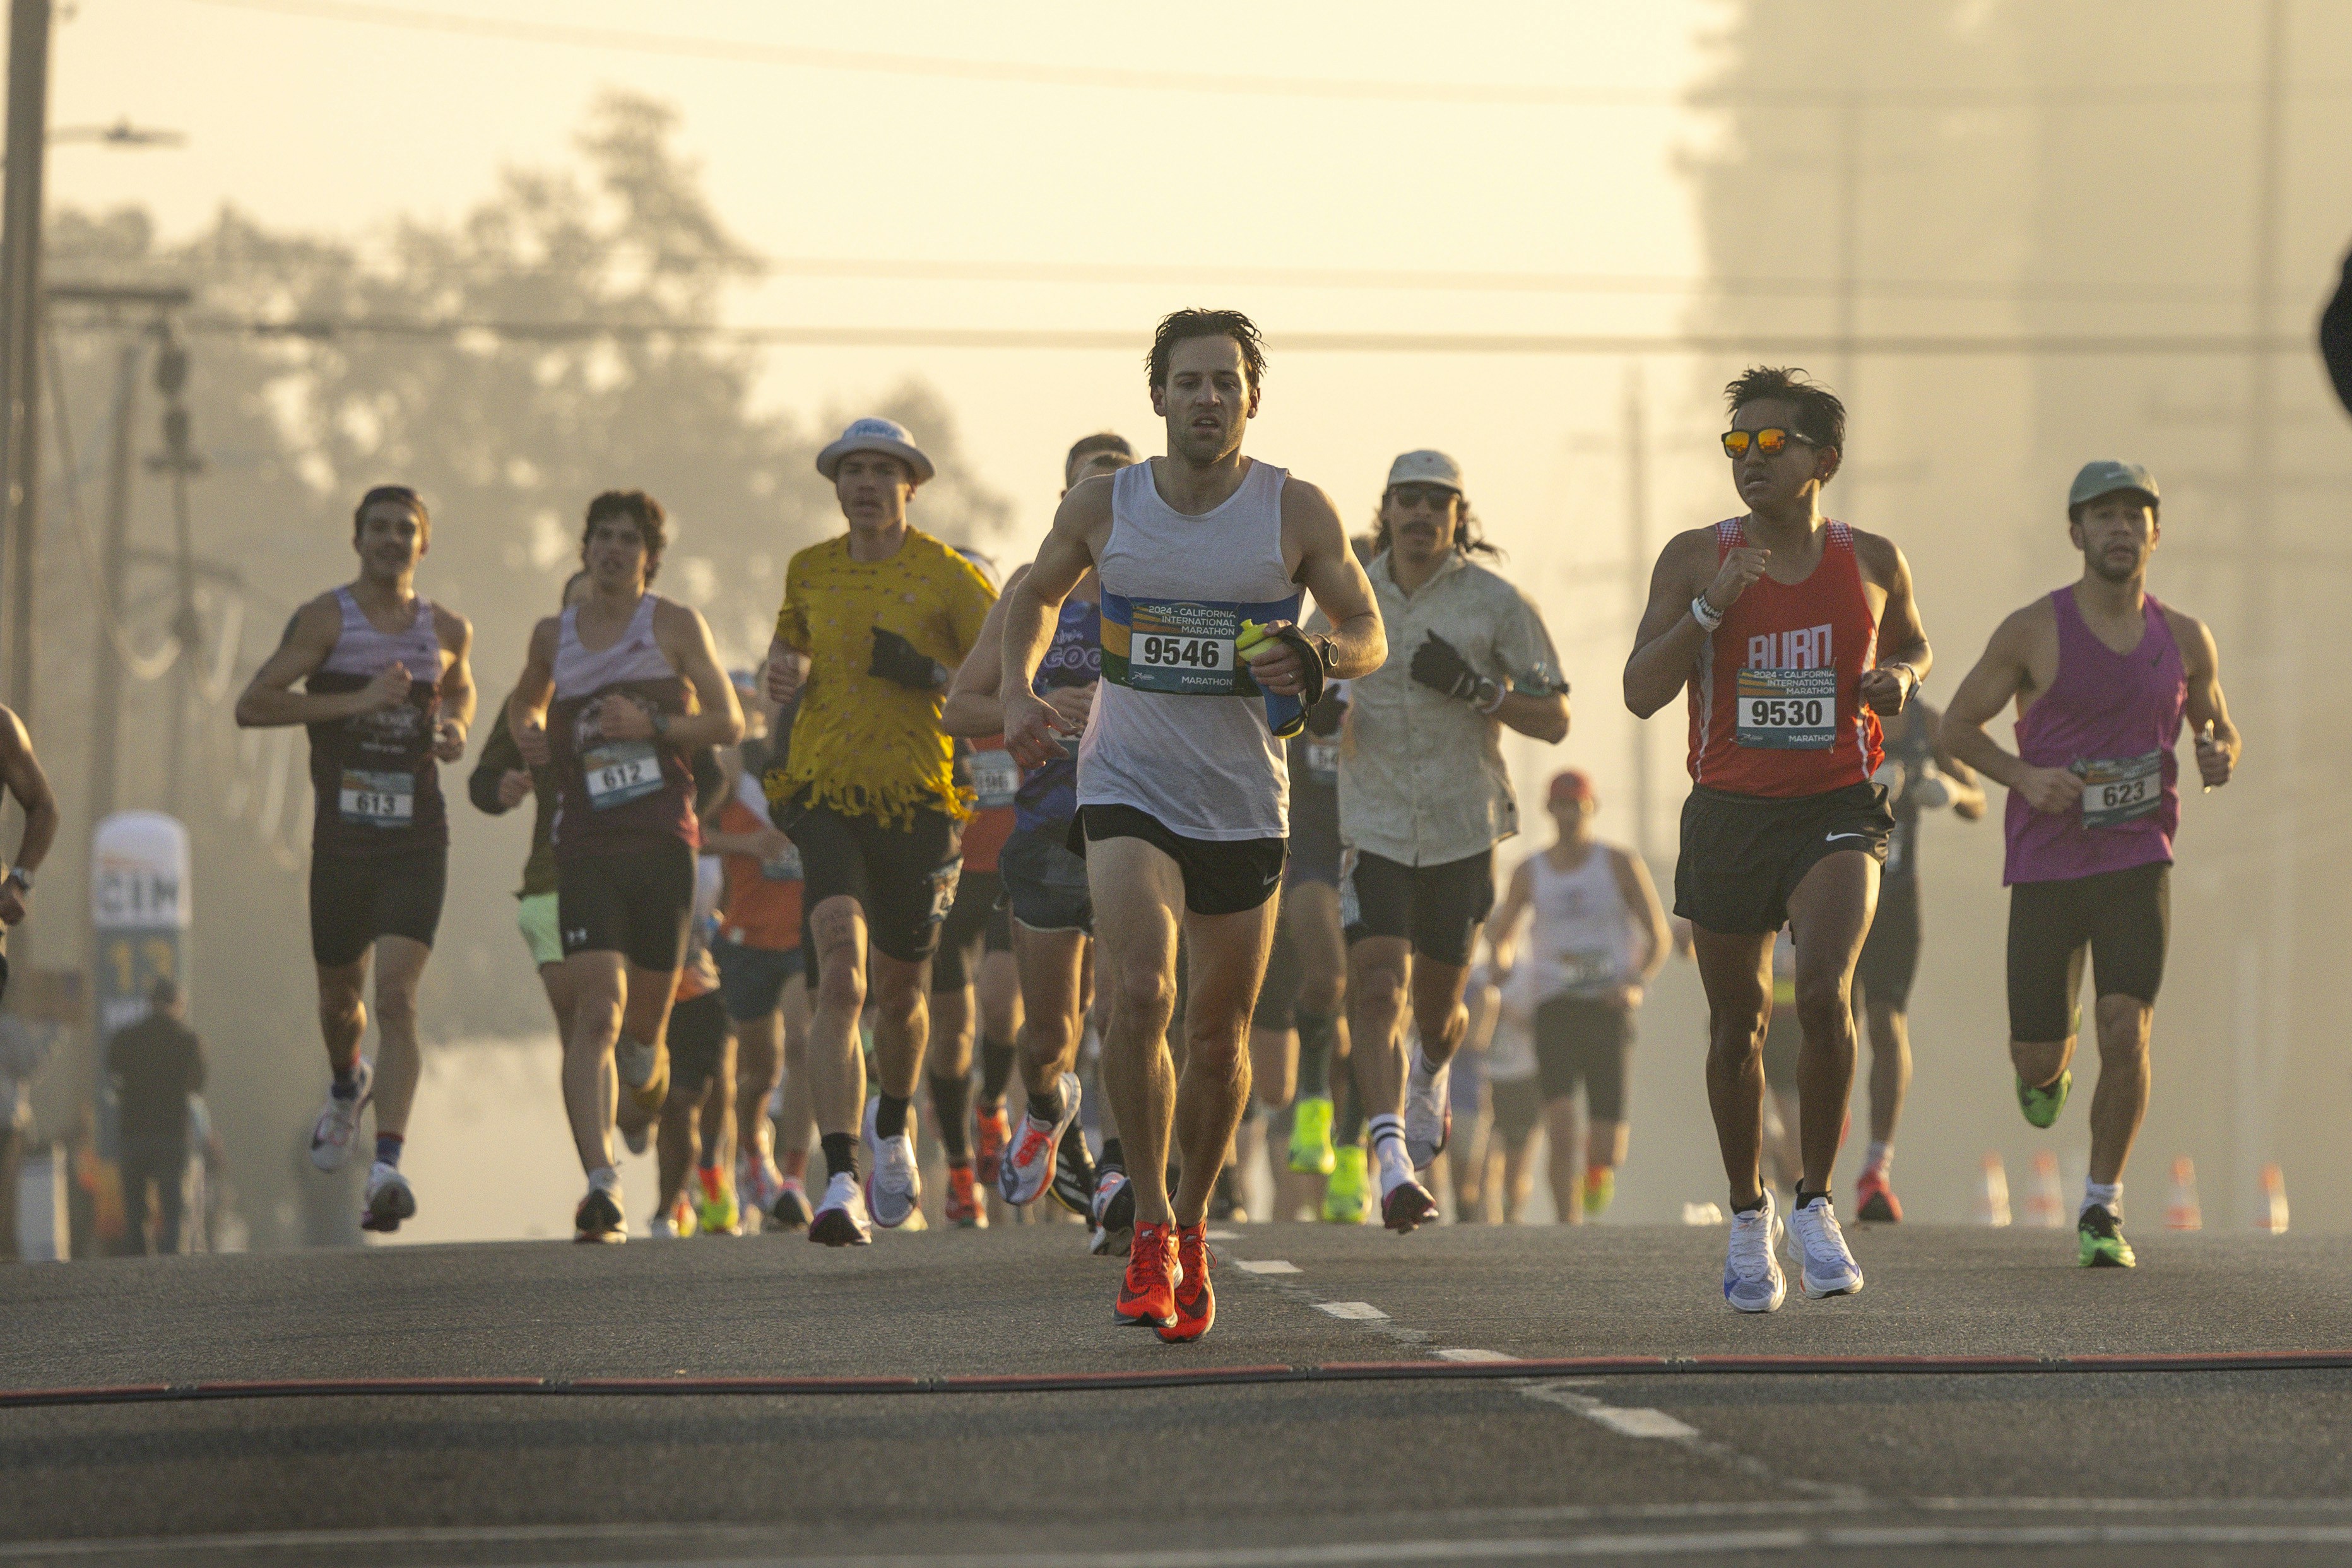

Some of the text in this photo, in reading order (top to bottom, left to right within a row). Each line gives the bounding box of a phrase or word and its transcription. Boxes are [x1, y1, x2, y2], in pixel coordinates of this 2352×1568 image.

[1149, 606, 1172, 614] 2024
[1179, 608, 1236, 618] CALIFORNIA
[1162, 616, 1235, 627] INTERNATIONAL
[1181, 626, 1235, 635] MARATHON
[1144, 637, 1219, 668] 9546
[1181, 676, 1233, 686] MARATHON
[1787, 687, 1835, 695] MARATHON
[1752, 700, 1823, 726] 9530
[1788, 734, 1835, 742] MARATHON
[2104, 781, 2144, 806] 623
[357, 791, 396, 815] 613
